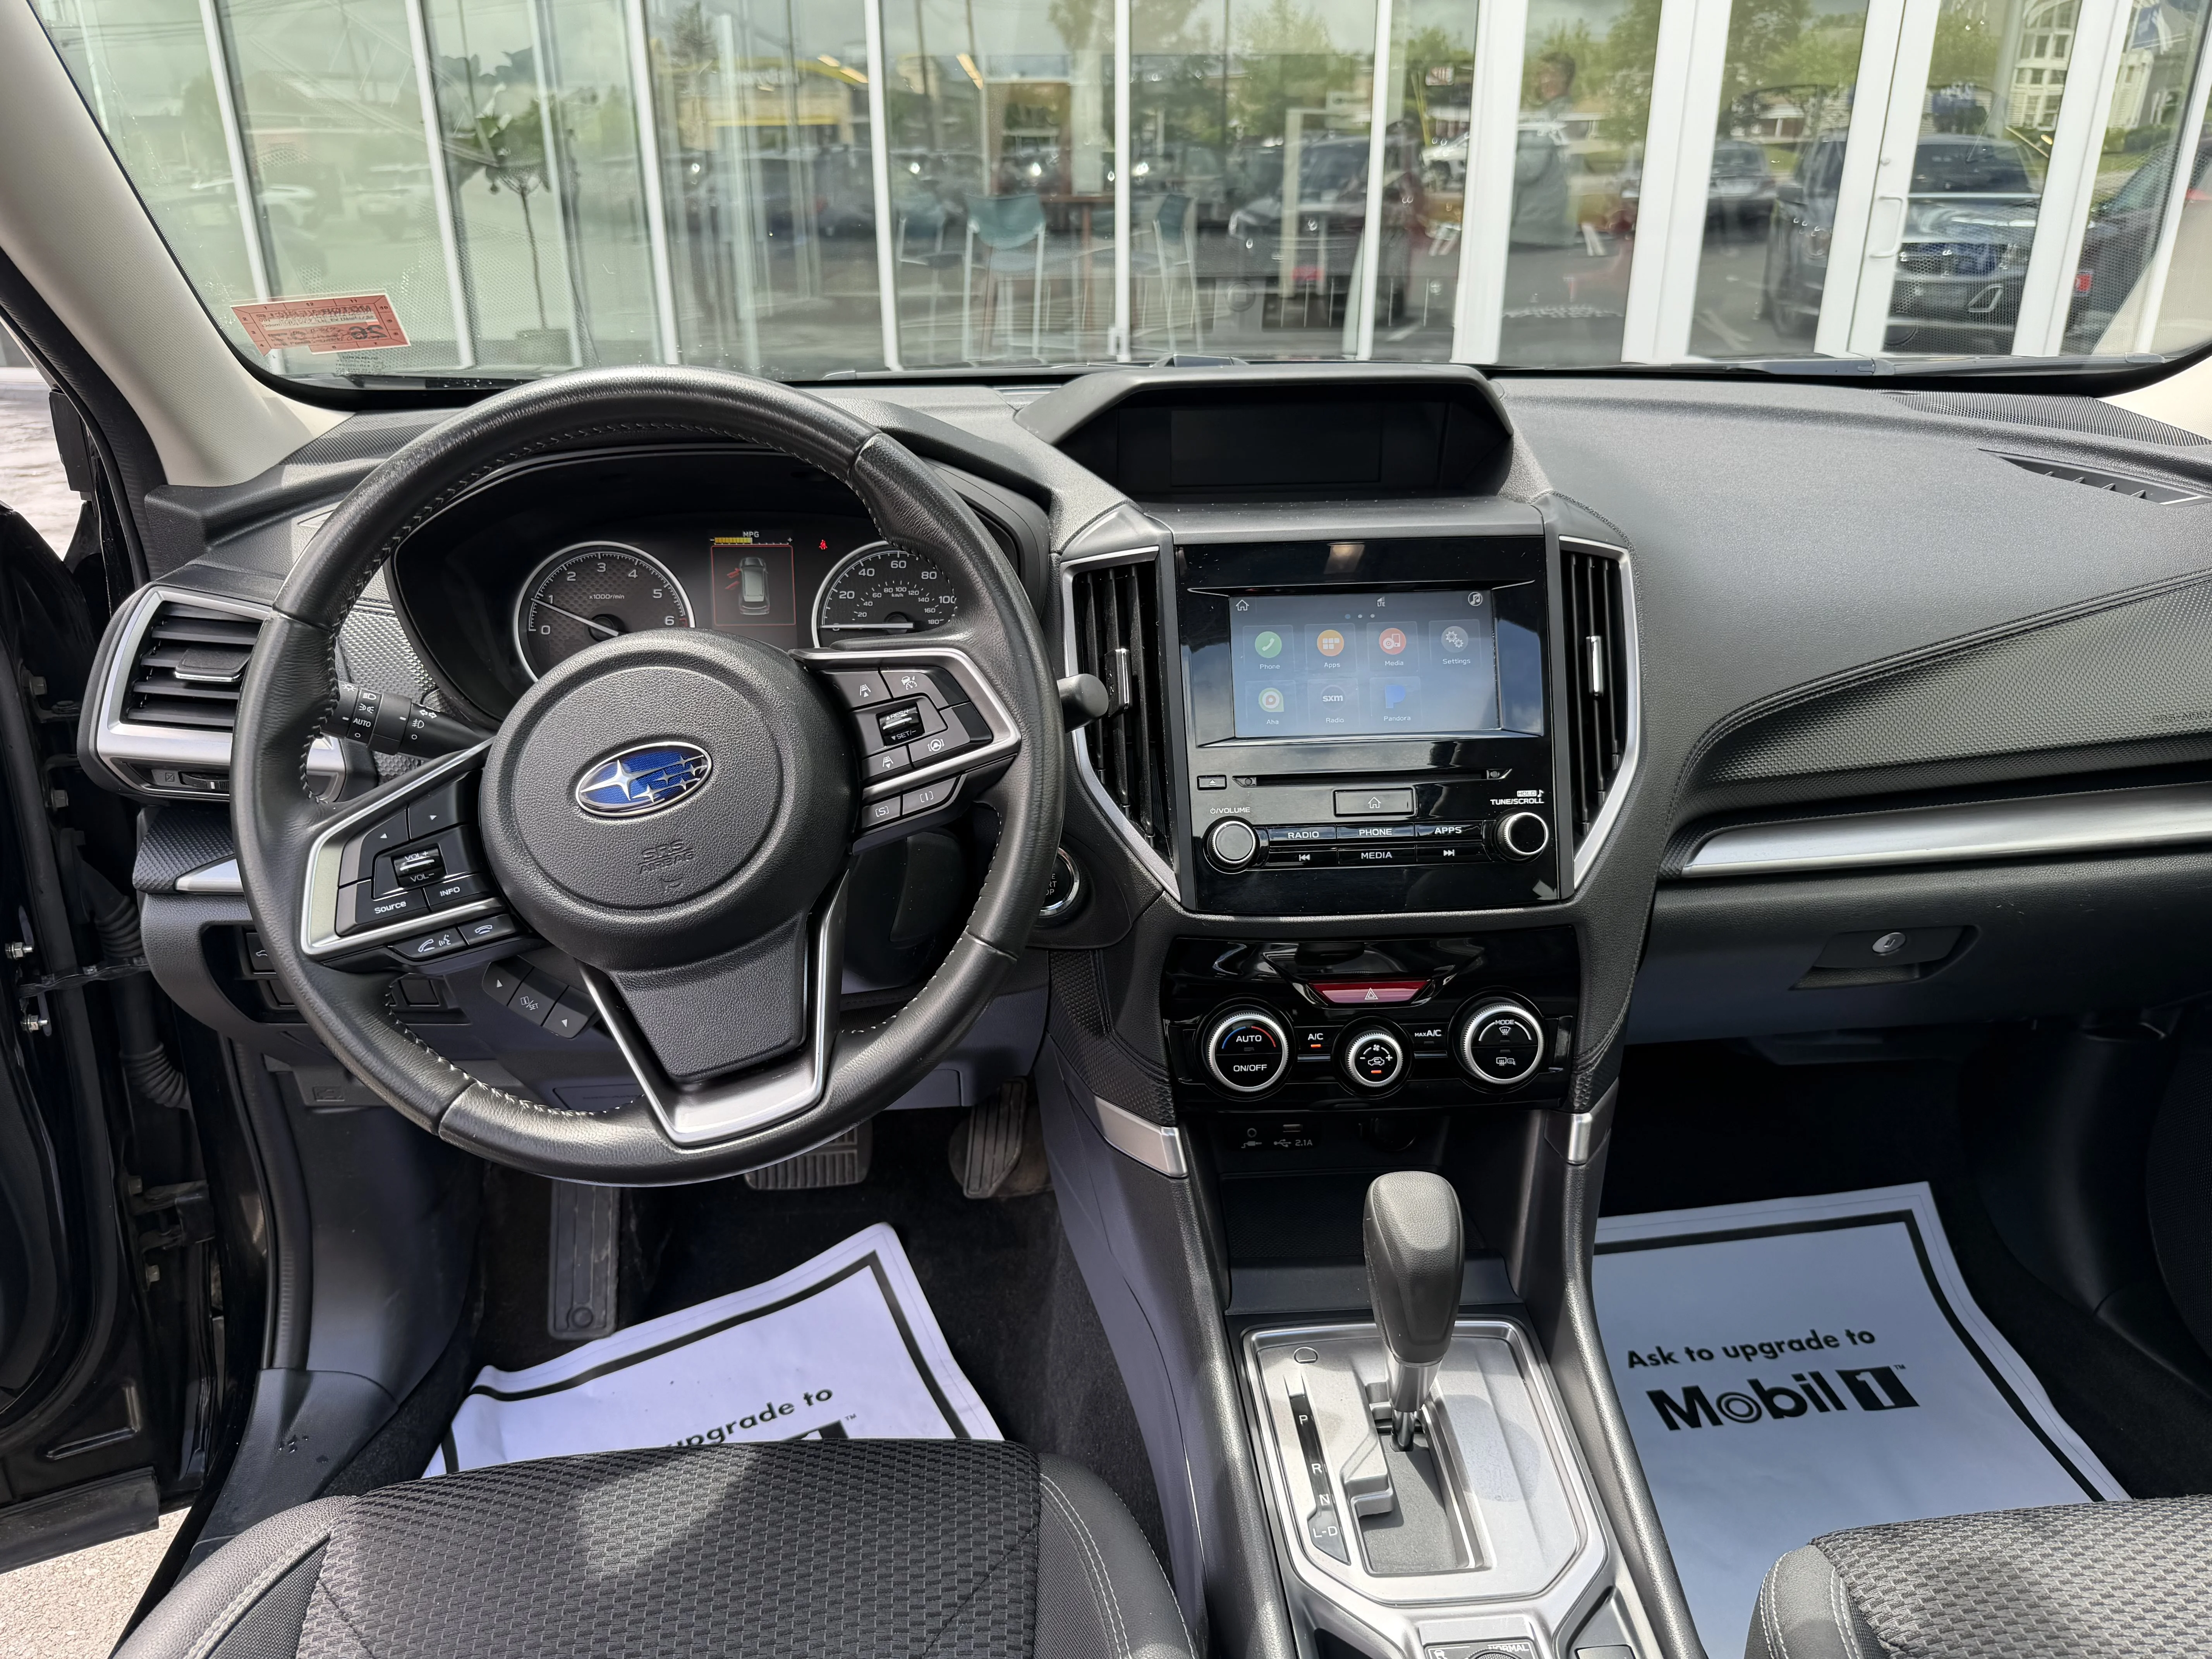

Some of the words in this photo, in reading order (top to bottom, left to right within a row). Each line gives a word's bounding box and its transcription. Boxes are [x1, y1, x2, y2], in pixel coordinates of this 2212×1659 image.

[597, 562, 606, 572] 3
[891, 560, 907, 568] 60
[567, 572, 576, 581] 2
[628, 570, 638, 579] 4
[858, 568, 875, 577] 40
[921, 571, 937, 579] 80
[653, 589, 662, 598] 5
[839, 591, 855, 599] 20
[548, 595, 553, 604] 1
[938, 596, 955, 604] 100
[665, 616, 675, 626] 6
[541, 625, 551, 635] 0
[353, 718, 371, 728] AUTO
[1288, 831, 1319, 839] RADIO
[1434, 826, 1462, 835] APPS
[642, 840, 685, 860] SRS
[638, 852, 694, 874] AIRBAG
[440, 886, 460, 897] INFO
[374, 901, 407, 914] Source
[1308, 1033, 1323, 1041] A/C
[1233, 1064, 1267, 1072] ON/OFF
[1627, 1346, 1680, 1369] Ask
[1684, 1346, 1714, 1362] to
[1722, 1329, 1840, 1361] upgrade
[1845, 1329, 1875, 1345] to
[803, 1389, 833, 1406] to
[1646, 1371, 1848, 1431] Mobil
[1299, 1415, 1309, 1425] P
[1311, 1463, 1322, 1473] R
[1319, 1494, 1330, 1505] N
